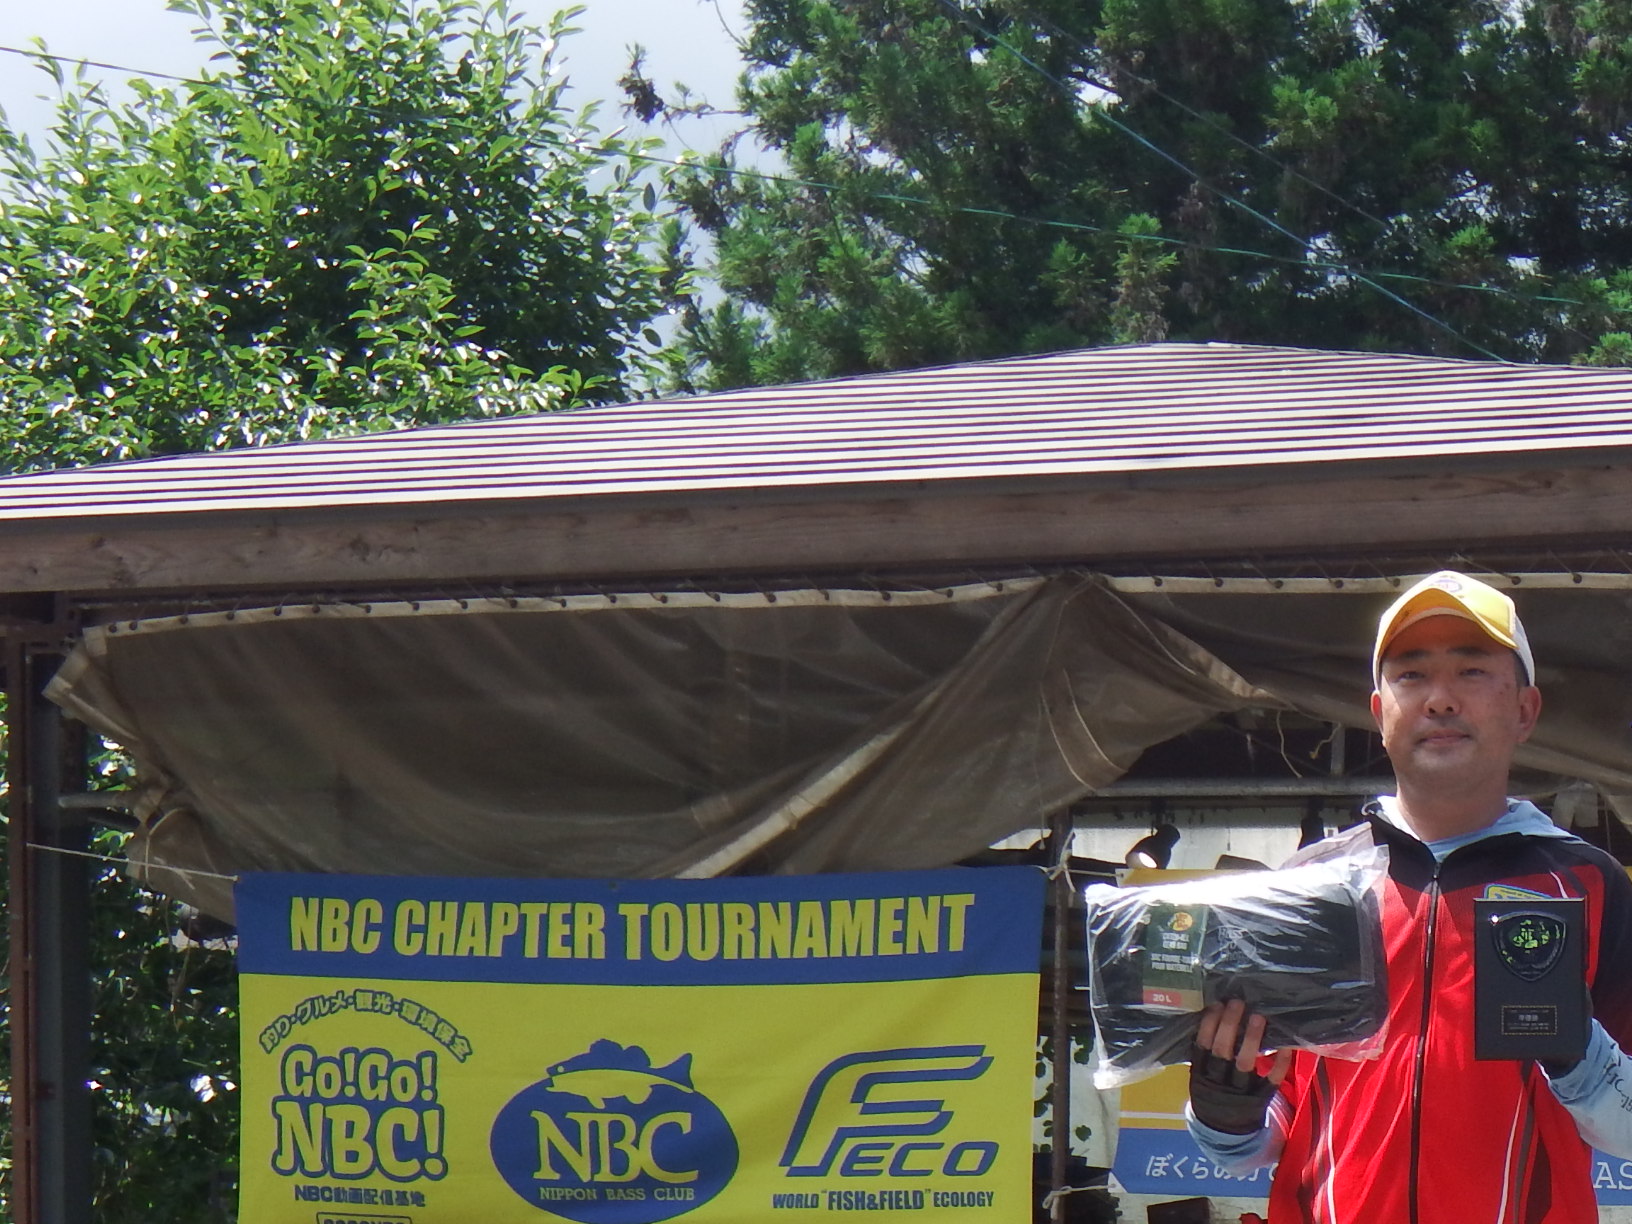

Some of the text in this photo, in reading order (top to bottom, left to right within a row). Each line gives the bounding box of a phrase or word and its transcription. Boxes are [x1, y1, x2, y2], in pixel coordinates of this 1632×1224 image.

[290, 893, 976, 962] NBC CHAPTER TOURNAMENT
[281, 1044, 438, 1102] Go!Go!
[271, 1096, 448, 1183] NBC!
[530, 1110, 699, 1184] NBC
[539, 1187, 696, 1202] NIPPON BASS CLUB
[772, 1192, 820, 1210] WORLD
[933, 1190, 995, 1208] ECOLOGY
